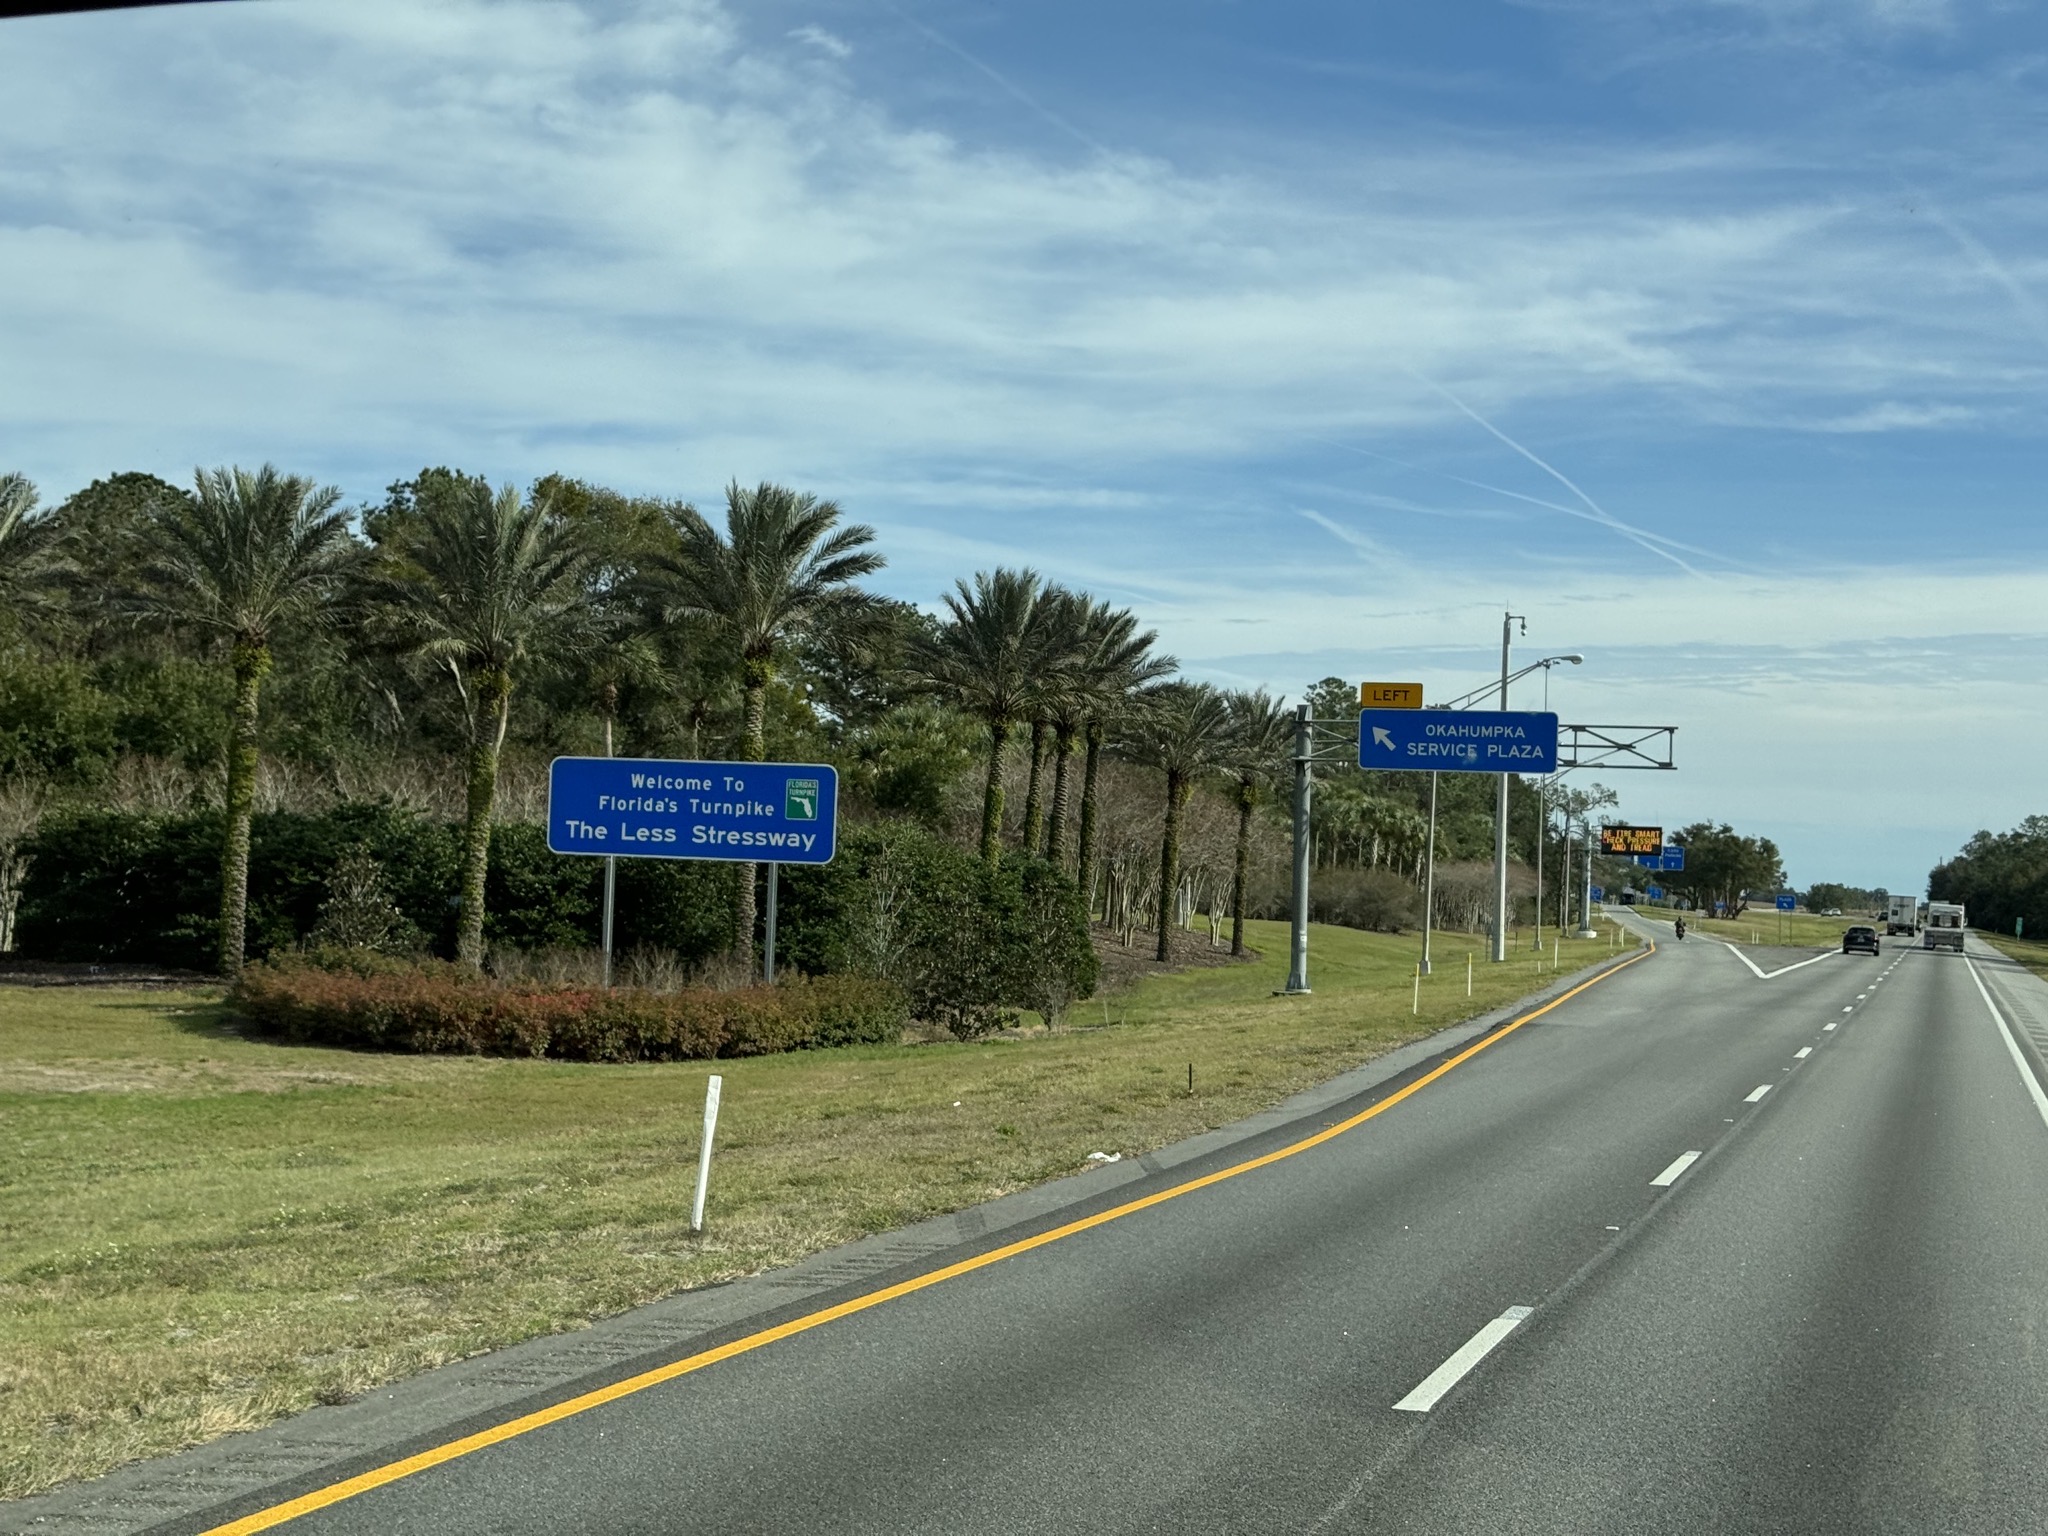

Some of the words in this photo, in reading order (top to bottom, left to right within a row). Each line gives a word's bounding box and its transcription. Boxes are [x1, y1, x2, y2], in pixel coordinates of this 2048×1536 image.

[1373, 690, 1410, 701] LEFT
[1425, 724, 1526, 738] OKAHUMPKA
[1407, 742, 1478, 757] SERVICE
[1487, 745, 1544, 758] PLAZA
[631, 773, 712, 791] Welcome
[723, 777, 744, 792] To
[599, 796, 678, 812] Florida's
[689, 799, 775, 817] Turnpike
[566, 820, 608, 839] The
[621, 823, 677, 842] Less
[691, 825, 817, 852] Stressway
[1628, 837, 1660, 845] PRESSURE
